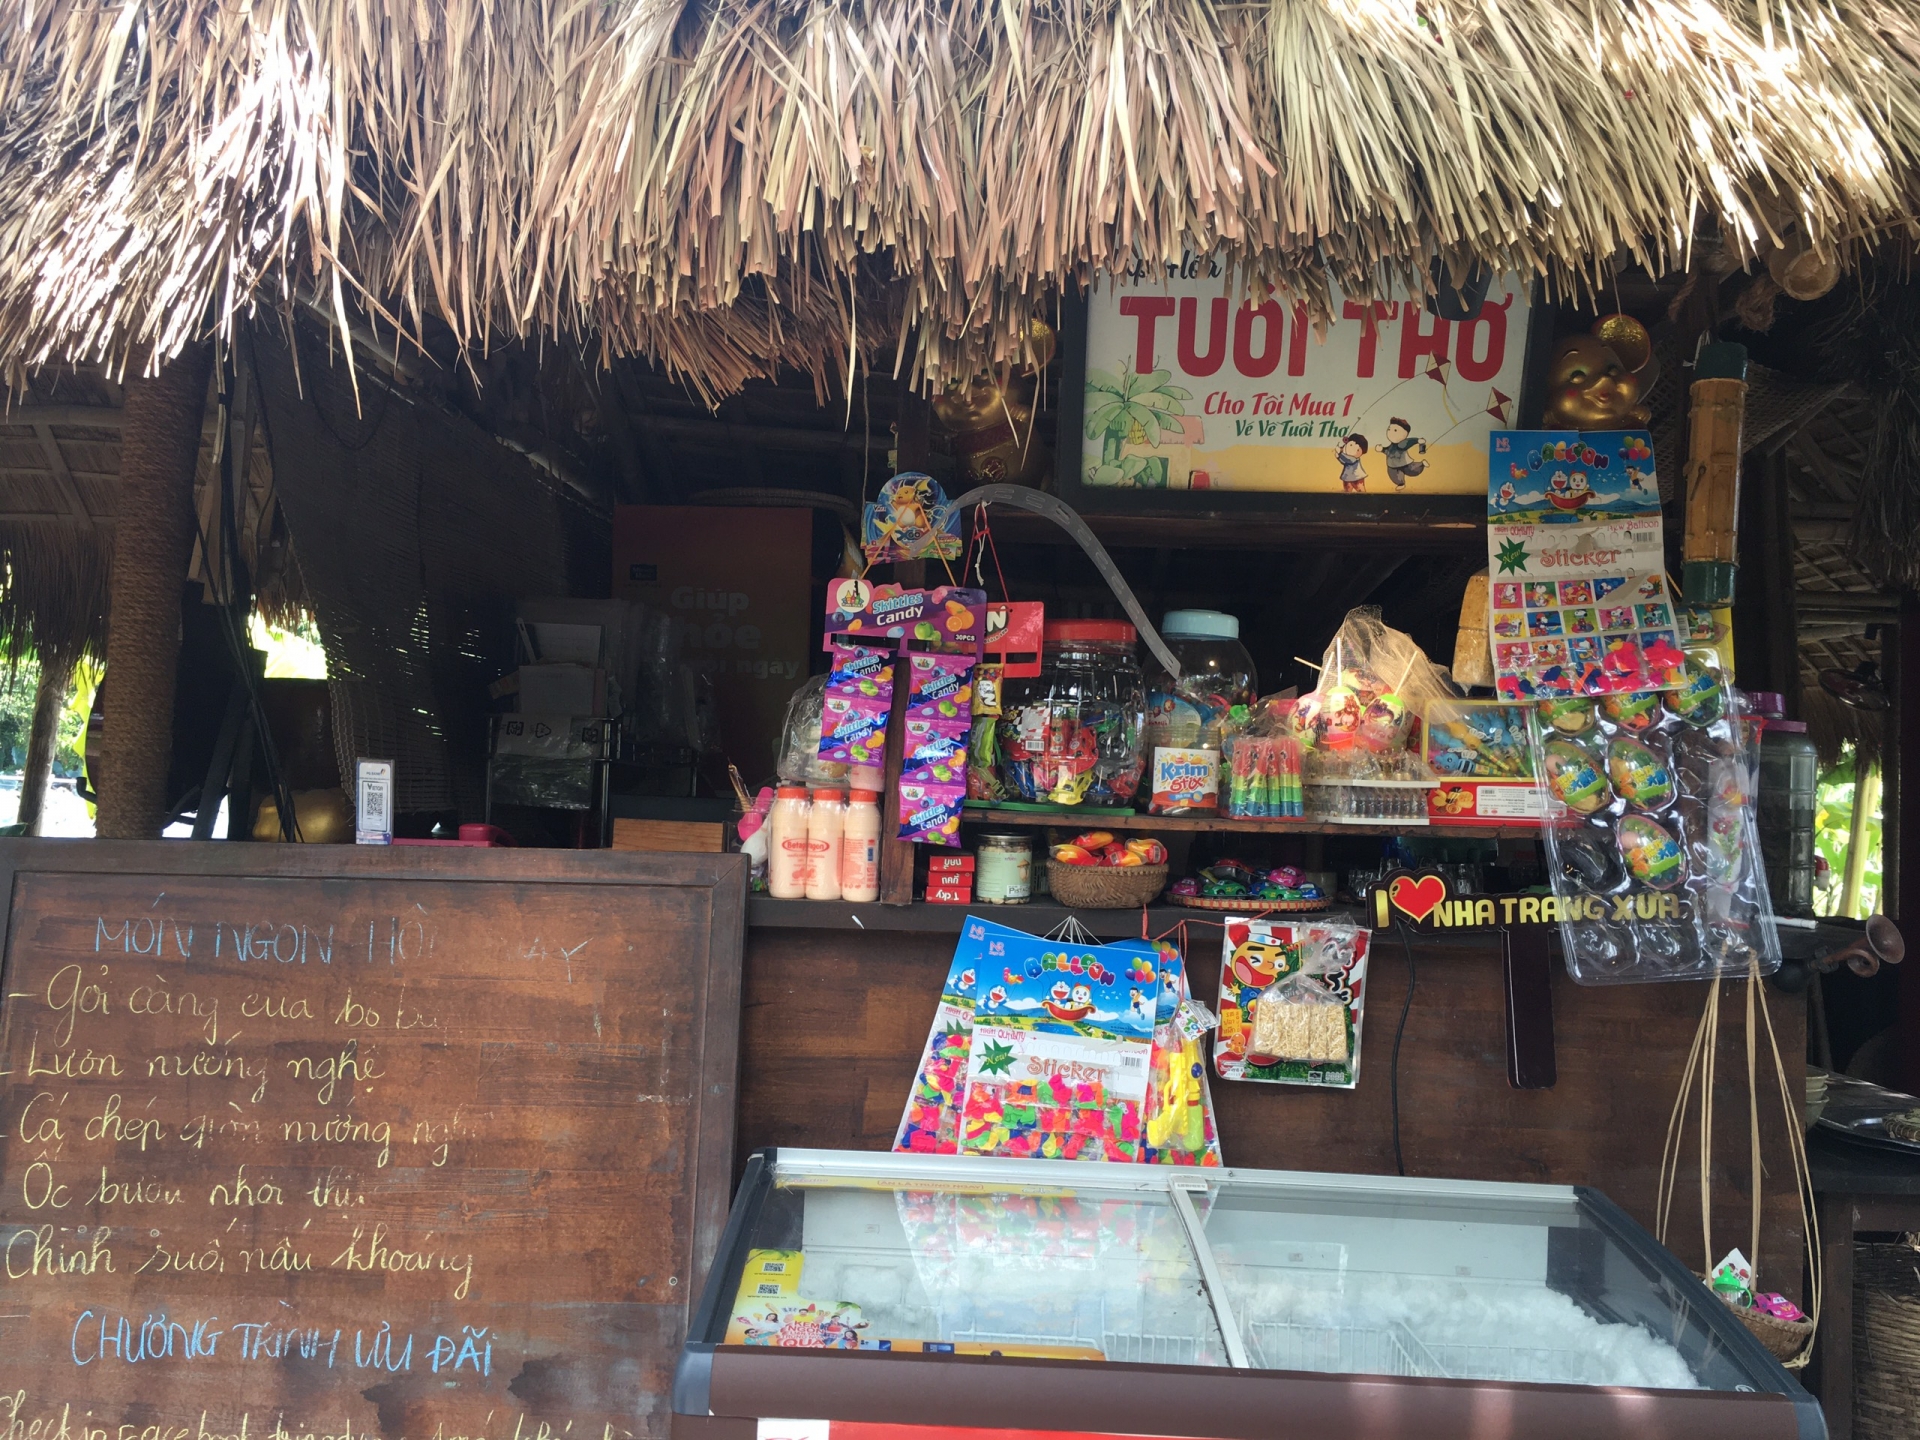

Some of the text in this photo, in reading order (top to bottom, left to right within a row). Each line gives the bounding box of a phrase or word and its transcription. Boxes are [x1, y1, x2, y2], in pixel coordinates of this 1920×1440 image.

[1342, 292, 1514, 383] THƠ
[1204, 391, 1355, 417] Cho Tôi Mua 1
[1235, 419, 1350, 438] Vé Về Tuổi Thơ
[1527, 440, 1610, 472] BALLOON
[1540, 549, 1621, 568] Sticker
[872, 592, 923, 615] Skittles
[876, 605, 925, 627] Candy
[955, 634, 976, 642] 30PCS
[843, 655, 880, 672] Skittles
[854, 663, 883, 679] Candy
[921, 673, 957, 695] Skittles
[932, 682, 960, 700] Candy
[834, 716, 871, 739] Skittles
[844, 726, 873, 744] Candy
[1161, 762, 1209, 781] Krim
[909, 803, 946, 827] Skittles
[920, 813, 948, 831] Candy
[1434, 898, 1496, 928] NHA
[1499, 896, 1606, 926] TRANG
[1611, 891, 1681, 922] XƯA
[95, 892, 194, 958] MÓN
[215, 920, 334, 965] NGON
[1024, 952, 1116, 987] BALLOON
[241, 991, 315, 1021] cua
[1027, 1056, 1111, 1082] Sticker
[19, 1092, 69, 1144] Cá
[85, 1093, 167, 1151] chép
[279, 1095, 392, 1168] nướng
[23, 1148, 74, 1210] Ốc
[794, 1320, 820, 1329] KEM
[71, 1309, 225, 1367] CHƯƠNG
[426, 1325, 498, 1378] ĐÃI
